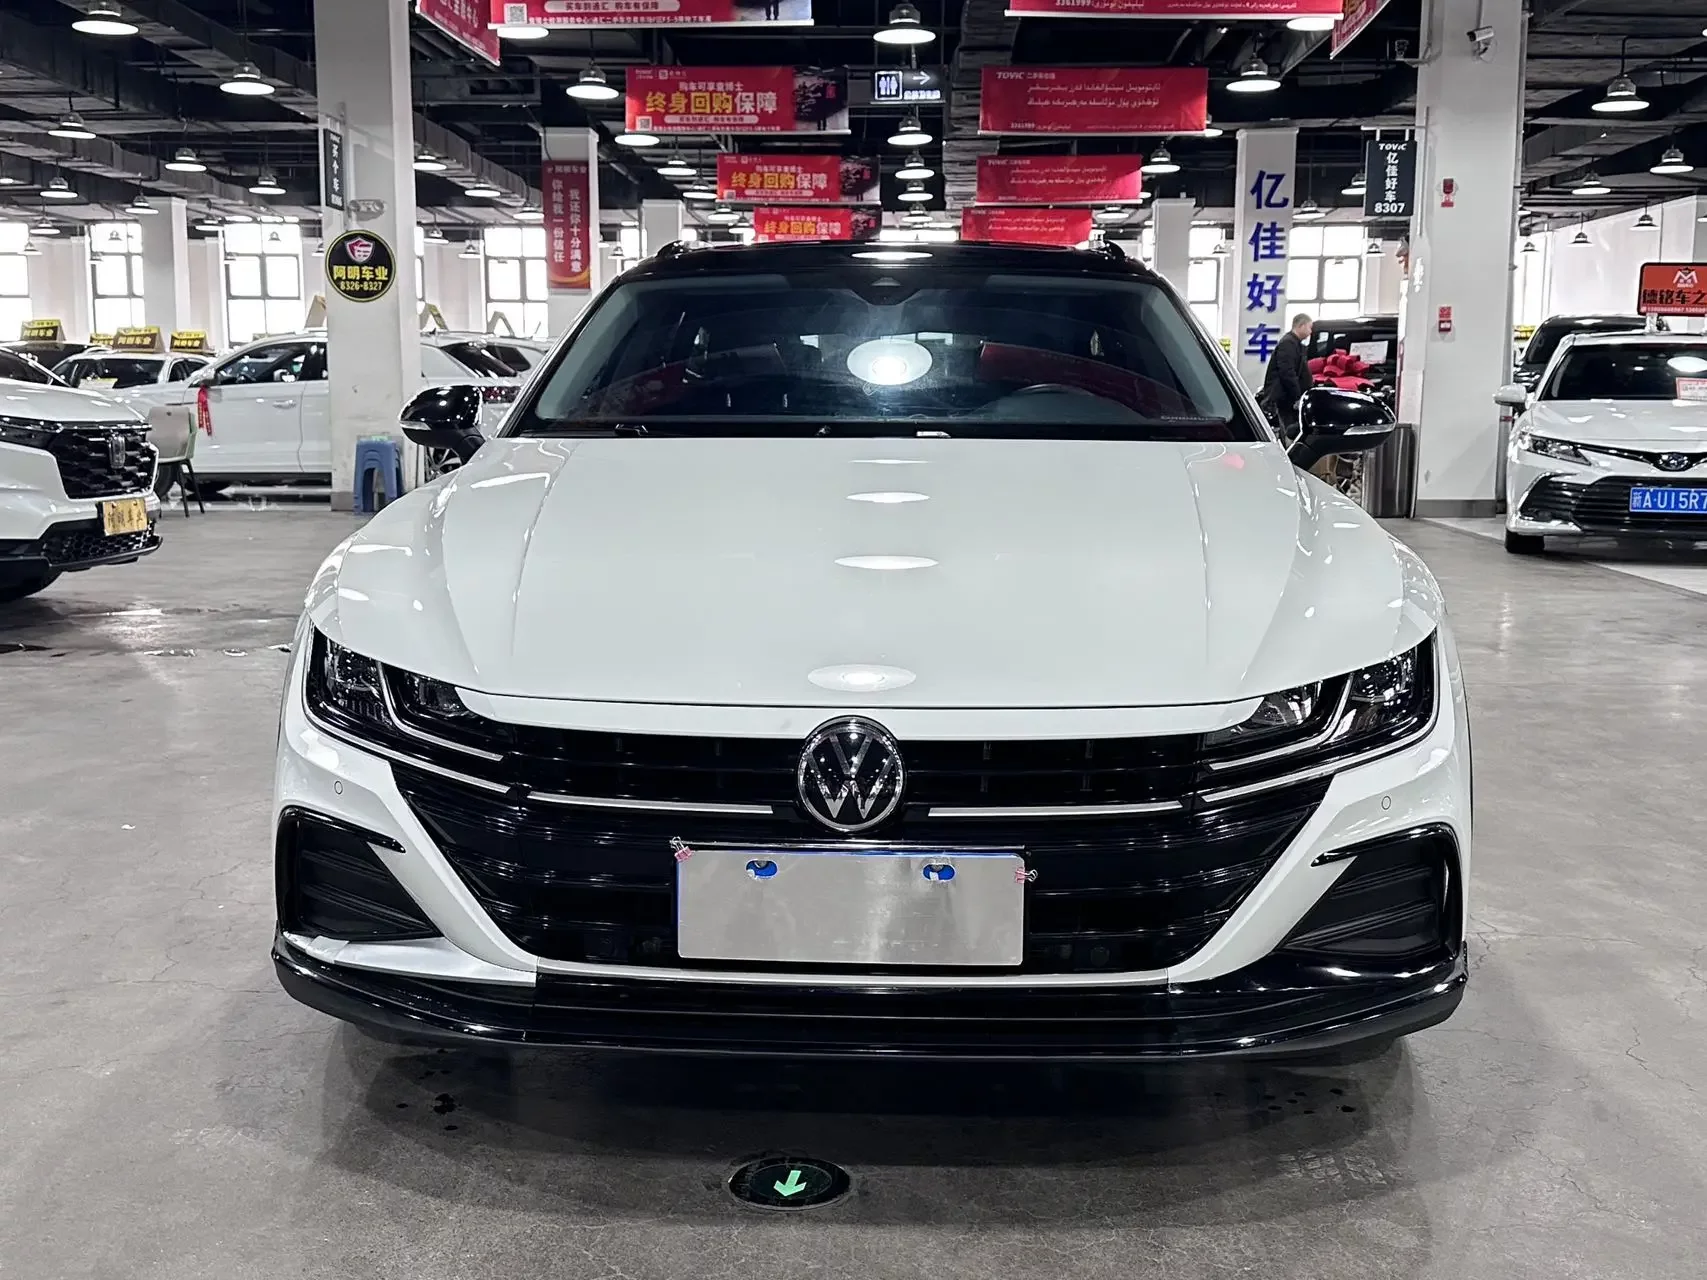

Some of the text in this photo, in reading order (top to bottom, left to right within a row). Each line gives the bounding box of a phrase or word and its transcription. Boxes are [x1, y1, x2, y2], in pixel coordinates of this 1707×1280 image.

[645, 91, 777, 114] 终身回购保障
[731, 172, 828, 190] 终身回购保障
[1385, 152, 1399, 203] 亿佳好车
[1374, 202, 1405, 213] 8307
[764, 220, 841, 235] 终身回购保障
[333, 265, 388, 281] 阿明车业
[1244, 170, 1289, 362] 亿佳好车
[340, 281, 383, 291] 8326-8327
